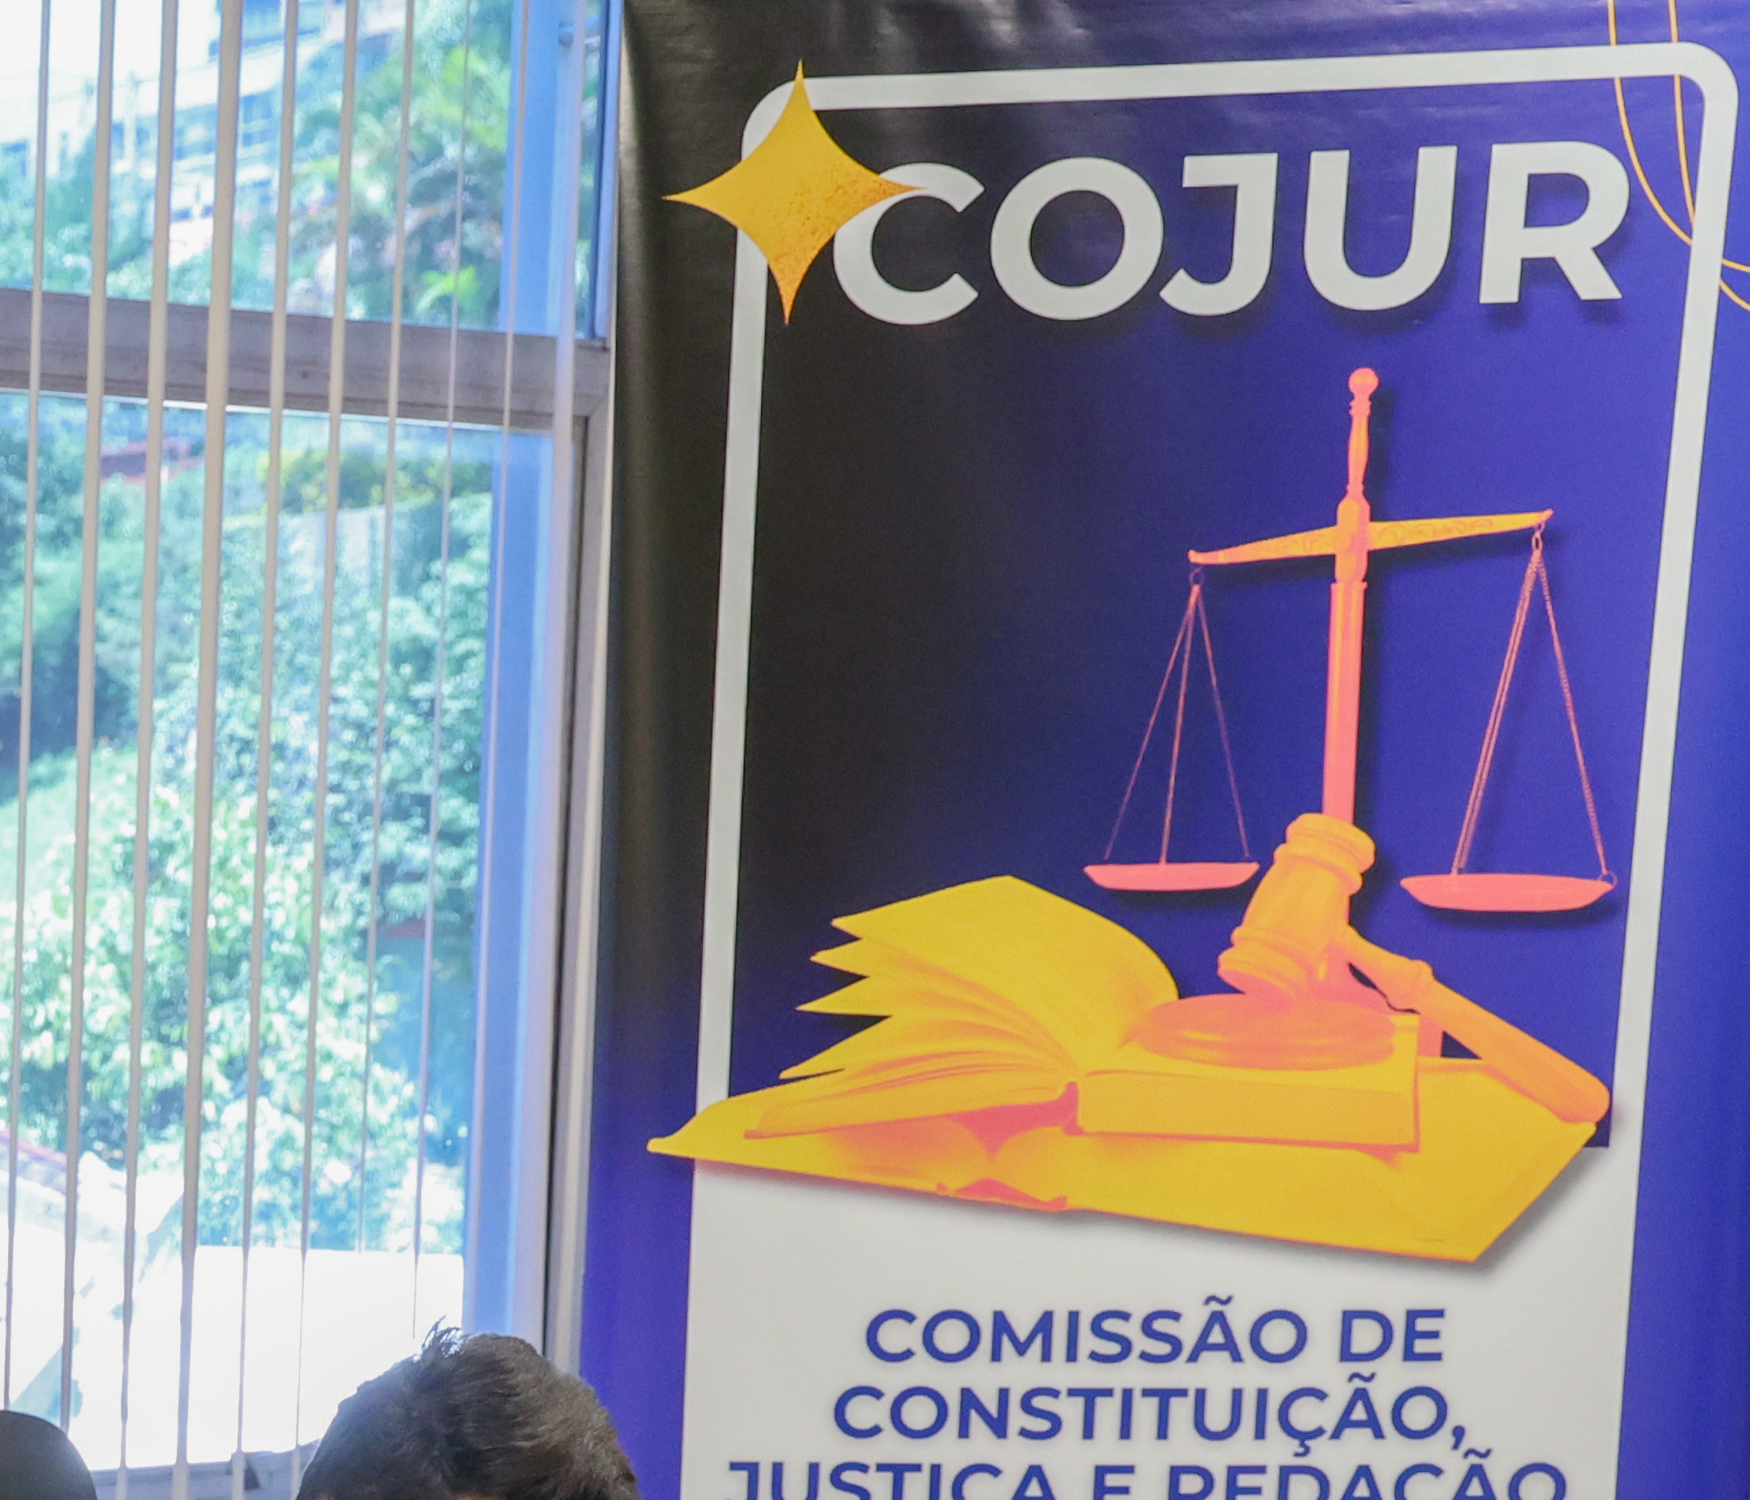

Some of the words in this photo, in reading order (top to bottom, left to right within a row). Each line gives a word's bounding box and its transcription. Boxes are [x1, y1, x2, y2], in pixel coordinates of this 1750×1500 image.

[833, 140, 1631, 325] COJUR
[865, 1296, 1309, 1366] COMISSÃO
[1340, 1308, 1446, 1364] DE
[833, 1372, 1466, 1455] CONSTITUIÇÃO,
